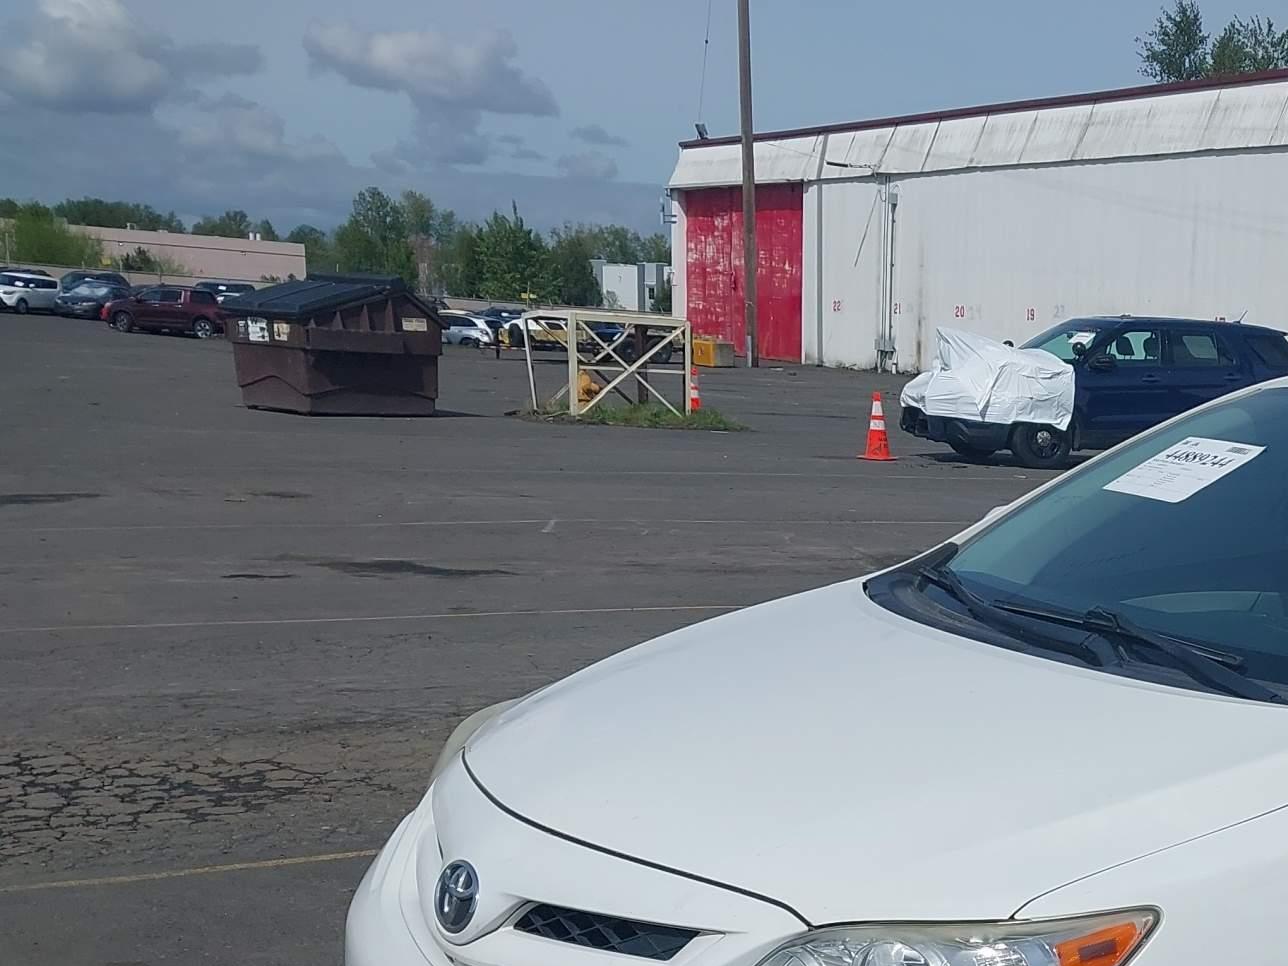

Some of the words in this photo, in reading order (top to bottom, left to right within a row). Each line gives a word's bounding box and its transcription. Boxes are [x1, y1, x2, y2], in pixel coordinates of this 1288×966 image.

[832, 300, 841, 312] 22
[893, 302, 902, 315] 21
[954, 305, 965, 318] 20
[1026, 308, 1035, 321] 19
